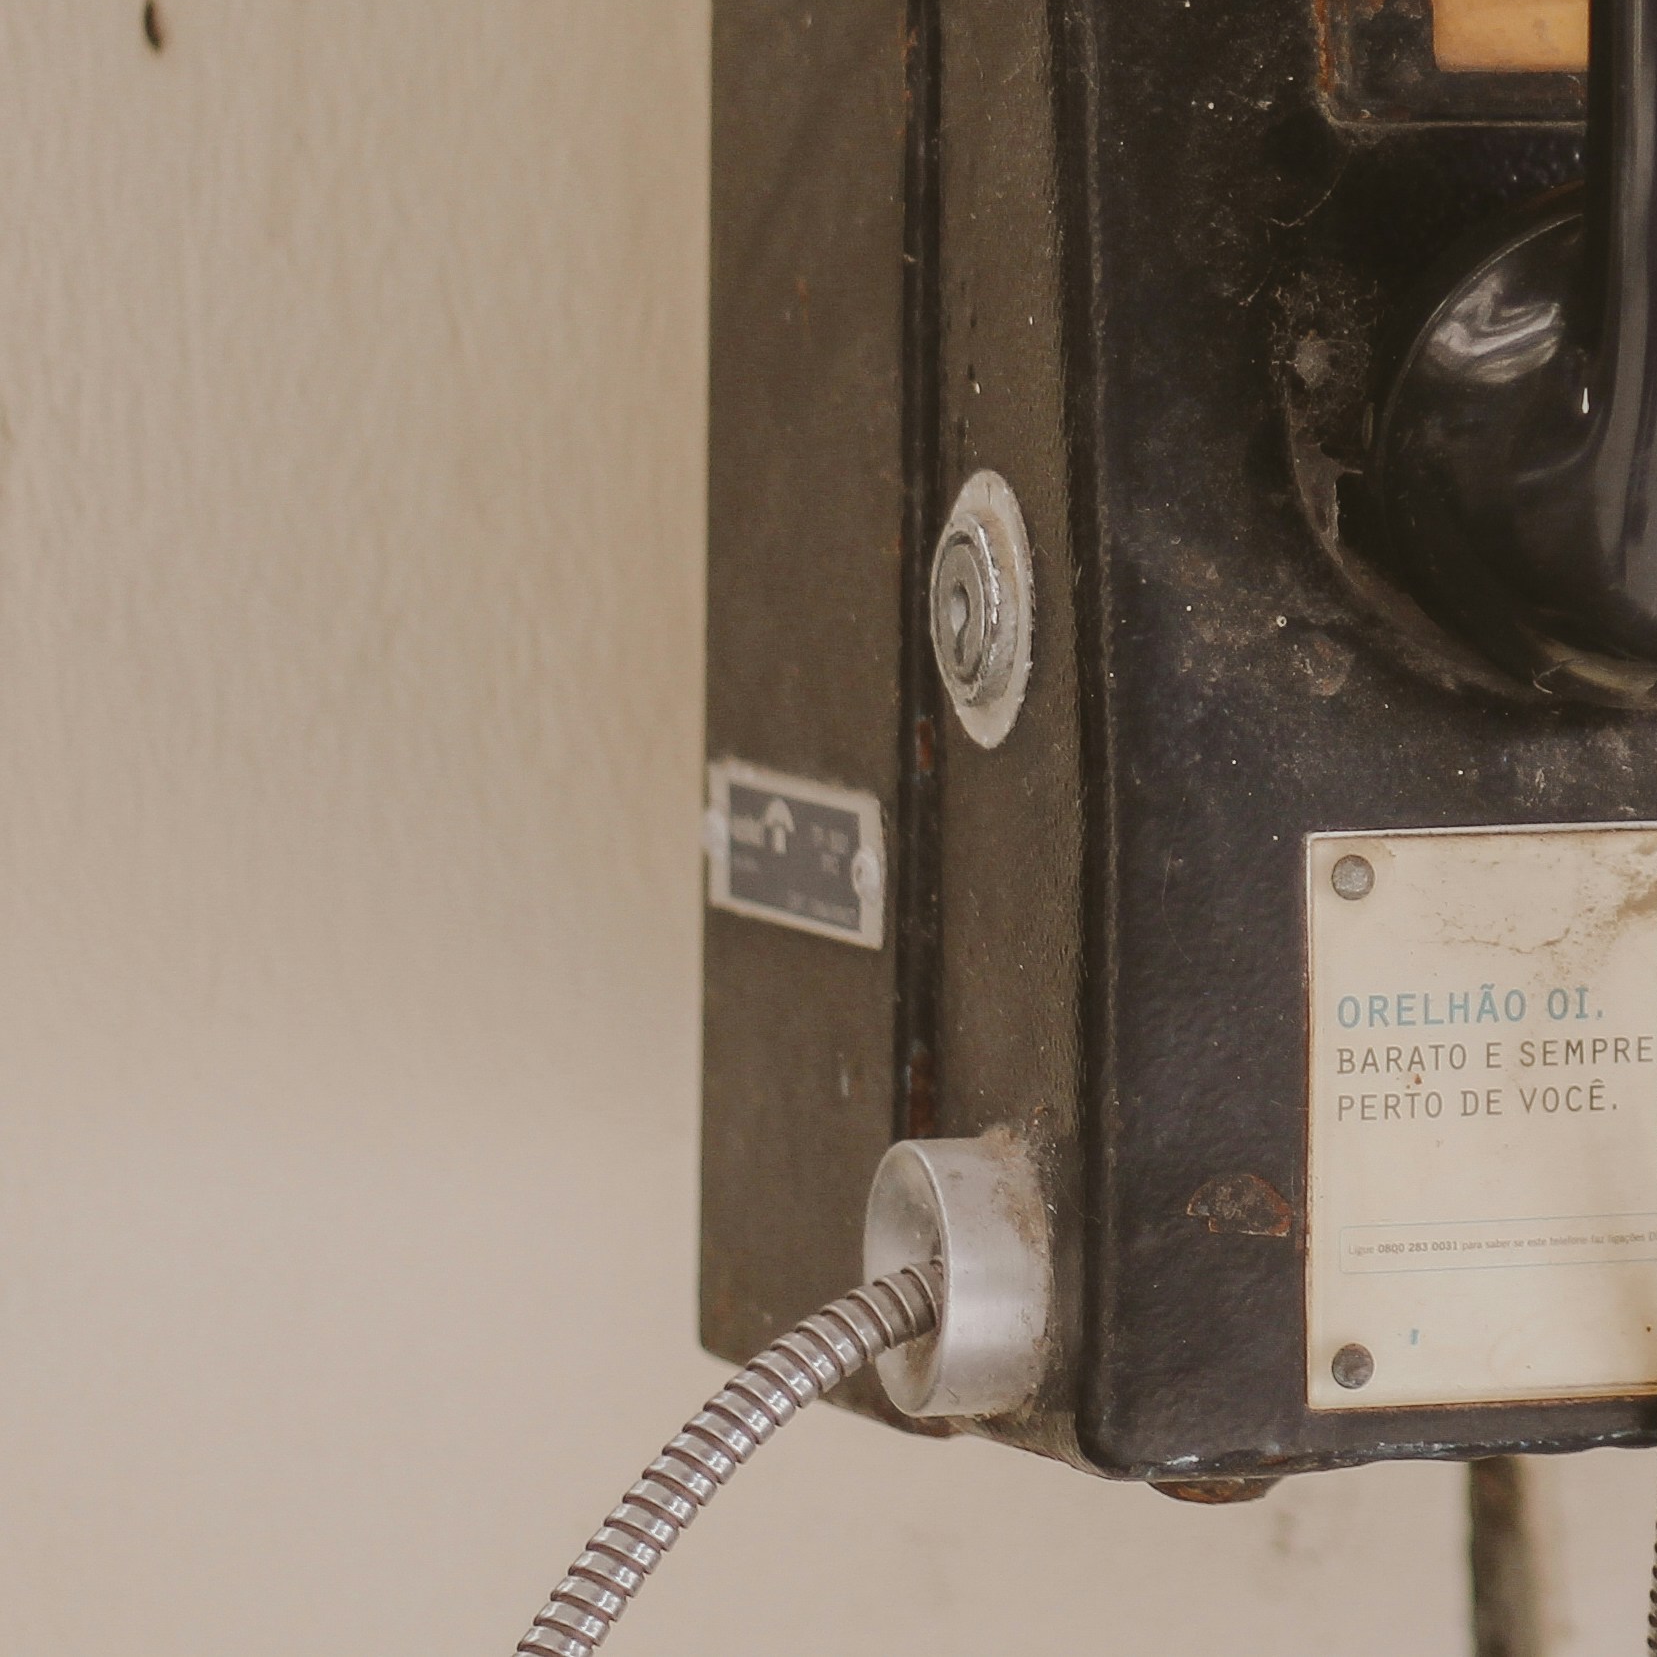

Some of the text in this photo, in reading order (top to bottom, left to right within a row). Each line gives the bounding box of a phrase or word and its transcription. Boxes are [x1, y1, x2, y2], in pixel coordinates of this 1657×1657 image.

[1337, 983, 1604, 1029] ORELHÃO OI.
[1336, 1035, 1655, 1074] BARATO E SEMPRE
[1337, 1078, 1618, 1122] PERTO DE VOCÊ.
